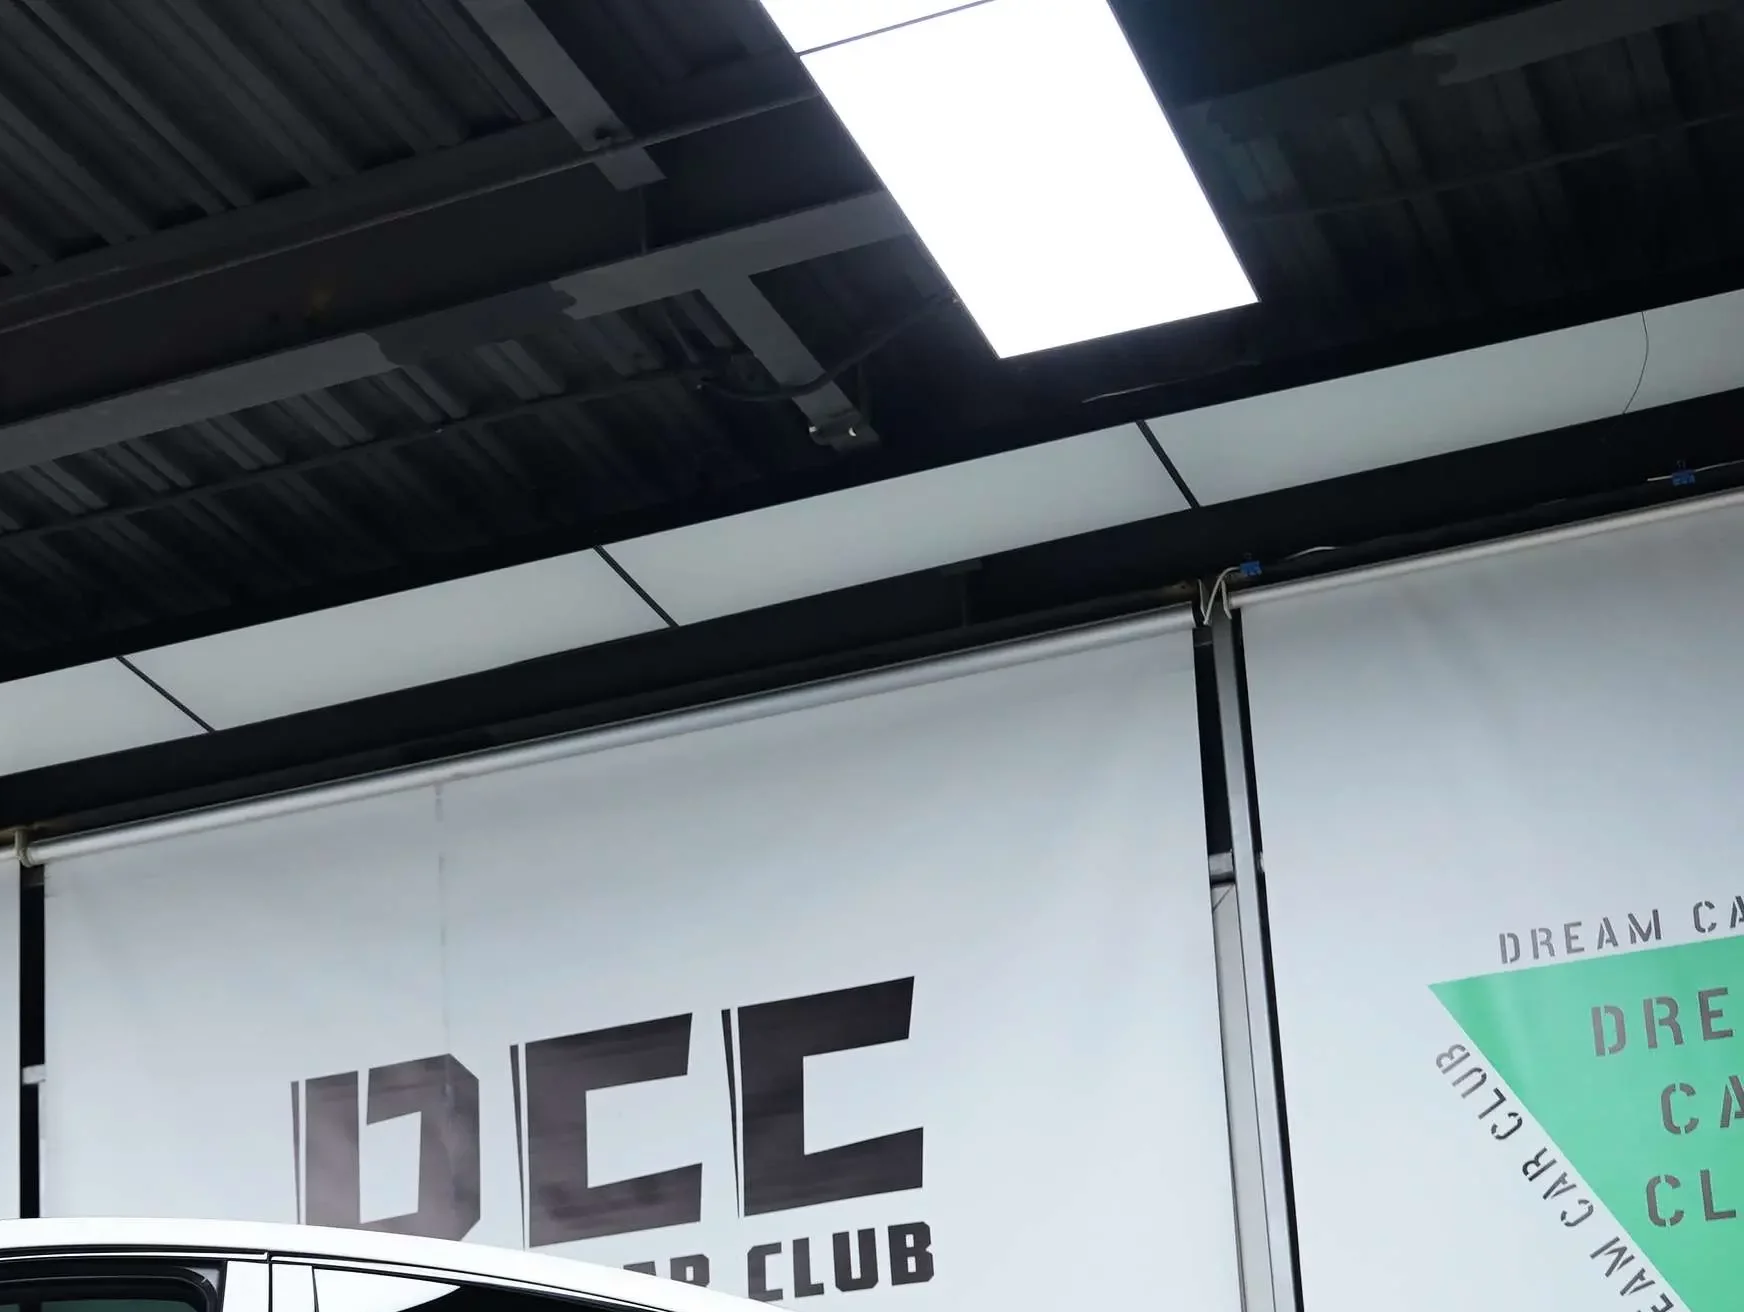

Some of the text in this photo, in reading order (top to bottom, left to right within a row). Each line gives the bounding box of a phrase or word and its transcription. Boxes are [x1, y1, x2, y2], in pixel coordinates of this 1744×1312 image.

[1498, 895, 1744, 965] DREAM CA
[1591, 986, 1735, 1057] DRE
[290, 975, 924, 1249] DCC
[1435, 1043, 1524, 1141] CLUB
[1660, 1074, 1744, 1135] CA
[1521, 1146, 1595, 1228] CAR
[1646, 1168, 1737, 1228] CL
[746, 1221, 935, 1303] CLUB
